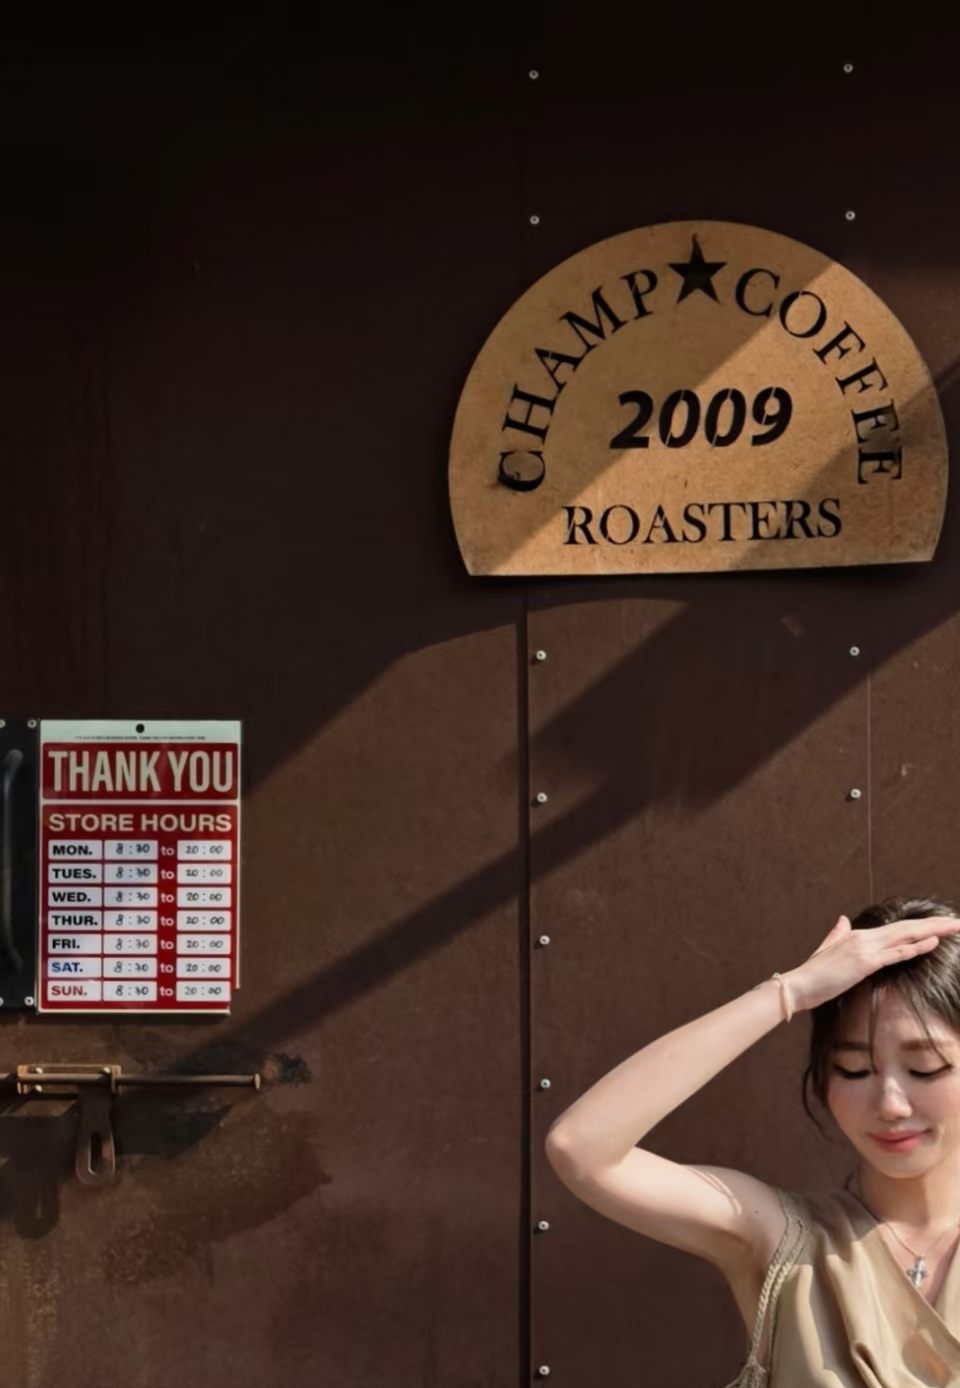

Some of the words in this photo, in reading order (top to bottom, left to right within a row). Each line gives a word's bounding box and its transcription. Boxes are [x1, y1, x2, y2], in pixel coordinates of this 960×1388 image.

[499, 268, 659, 492] CHAMP
[734, 267, 904, 485] COFFEE
[608, 386, 793, 450] 2009
[563, 498, 842, 546] ROASTERS
[48, 750, 162, 792] THANK
[167, 750, 233, 793] YOU
[49, 813, 134, 832] STORE
[141, 813, 232, 832] HOURS
[52, 845, 93, 856] MON.
[161, 847, 175, 856] to
[52, 868, 97, 879] TUES.
[161, 870, 175, 880] to
[52, 892, 91, 902] WED.
[161, 893, 175, 903] to
[52, 915, 98, 926] THUR.
[160, 917, 174, 927] to
[52, 939, 80, 949] FRI.
[160, 940, 174, 950] to
[52, 962, 83, 973] SAT.
[160, 963, 174, 973] to
[52, 986, 87, 996] SUN.
[160, 987, 174, 997] to
